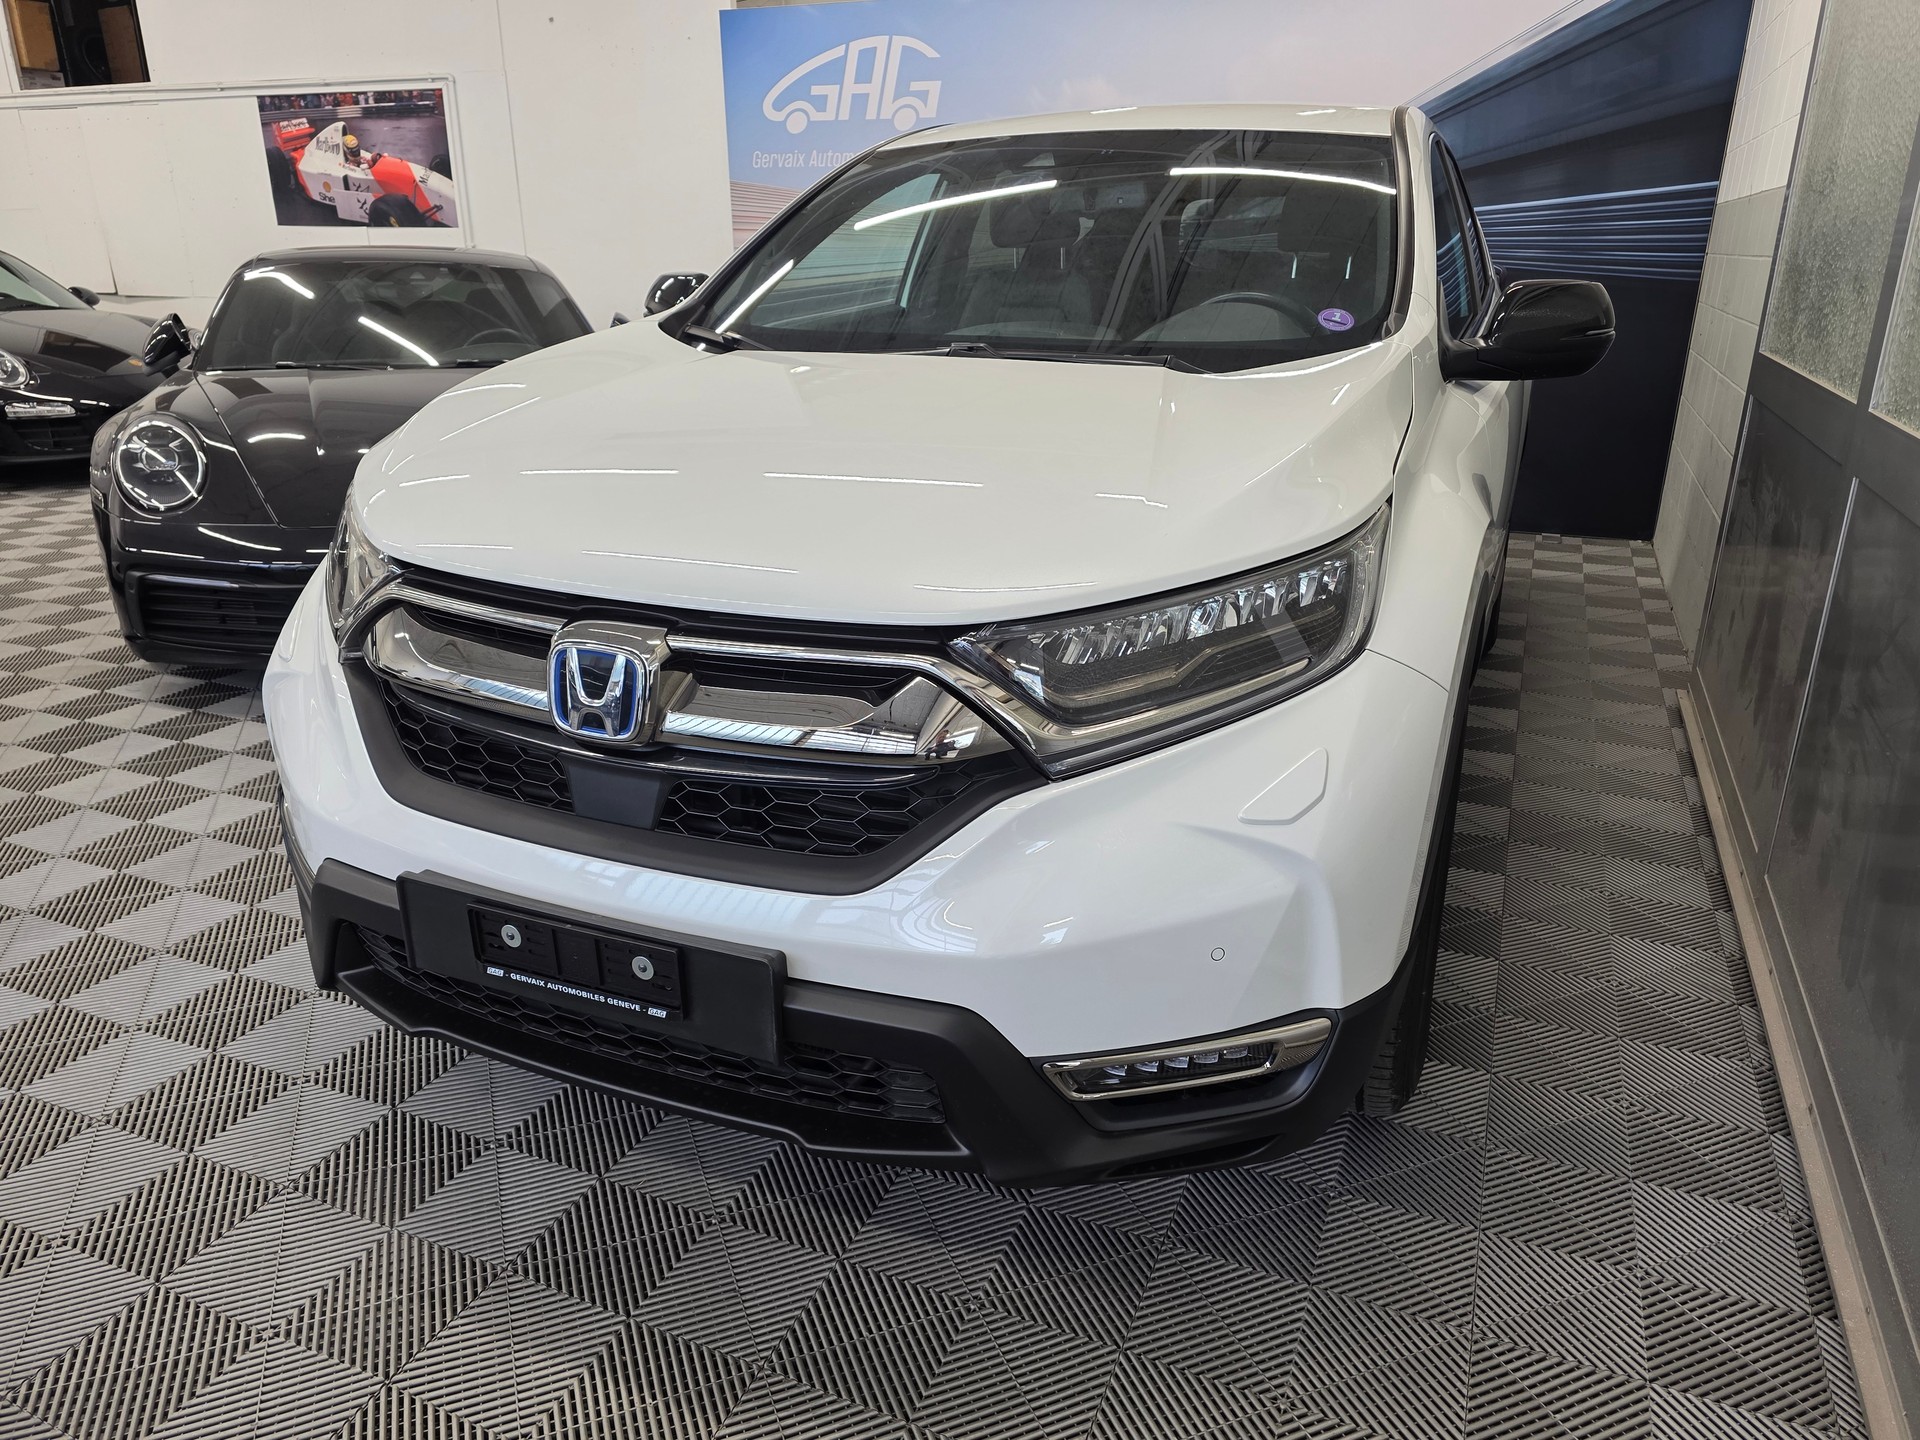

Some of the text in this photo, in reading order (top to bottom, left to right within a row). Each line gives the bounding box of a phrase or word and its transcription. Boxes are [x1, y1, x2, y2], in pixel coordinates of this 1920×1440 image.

[763, 35, 942, 133] GAG
[752, 150, 805, 168] Gervaix
[510, 973, 546, 987] GERVAIX
[547, 983, 605, 1003] AUTOMOBILES
[607, 998, 641, 1012] GENEVE
